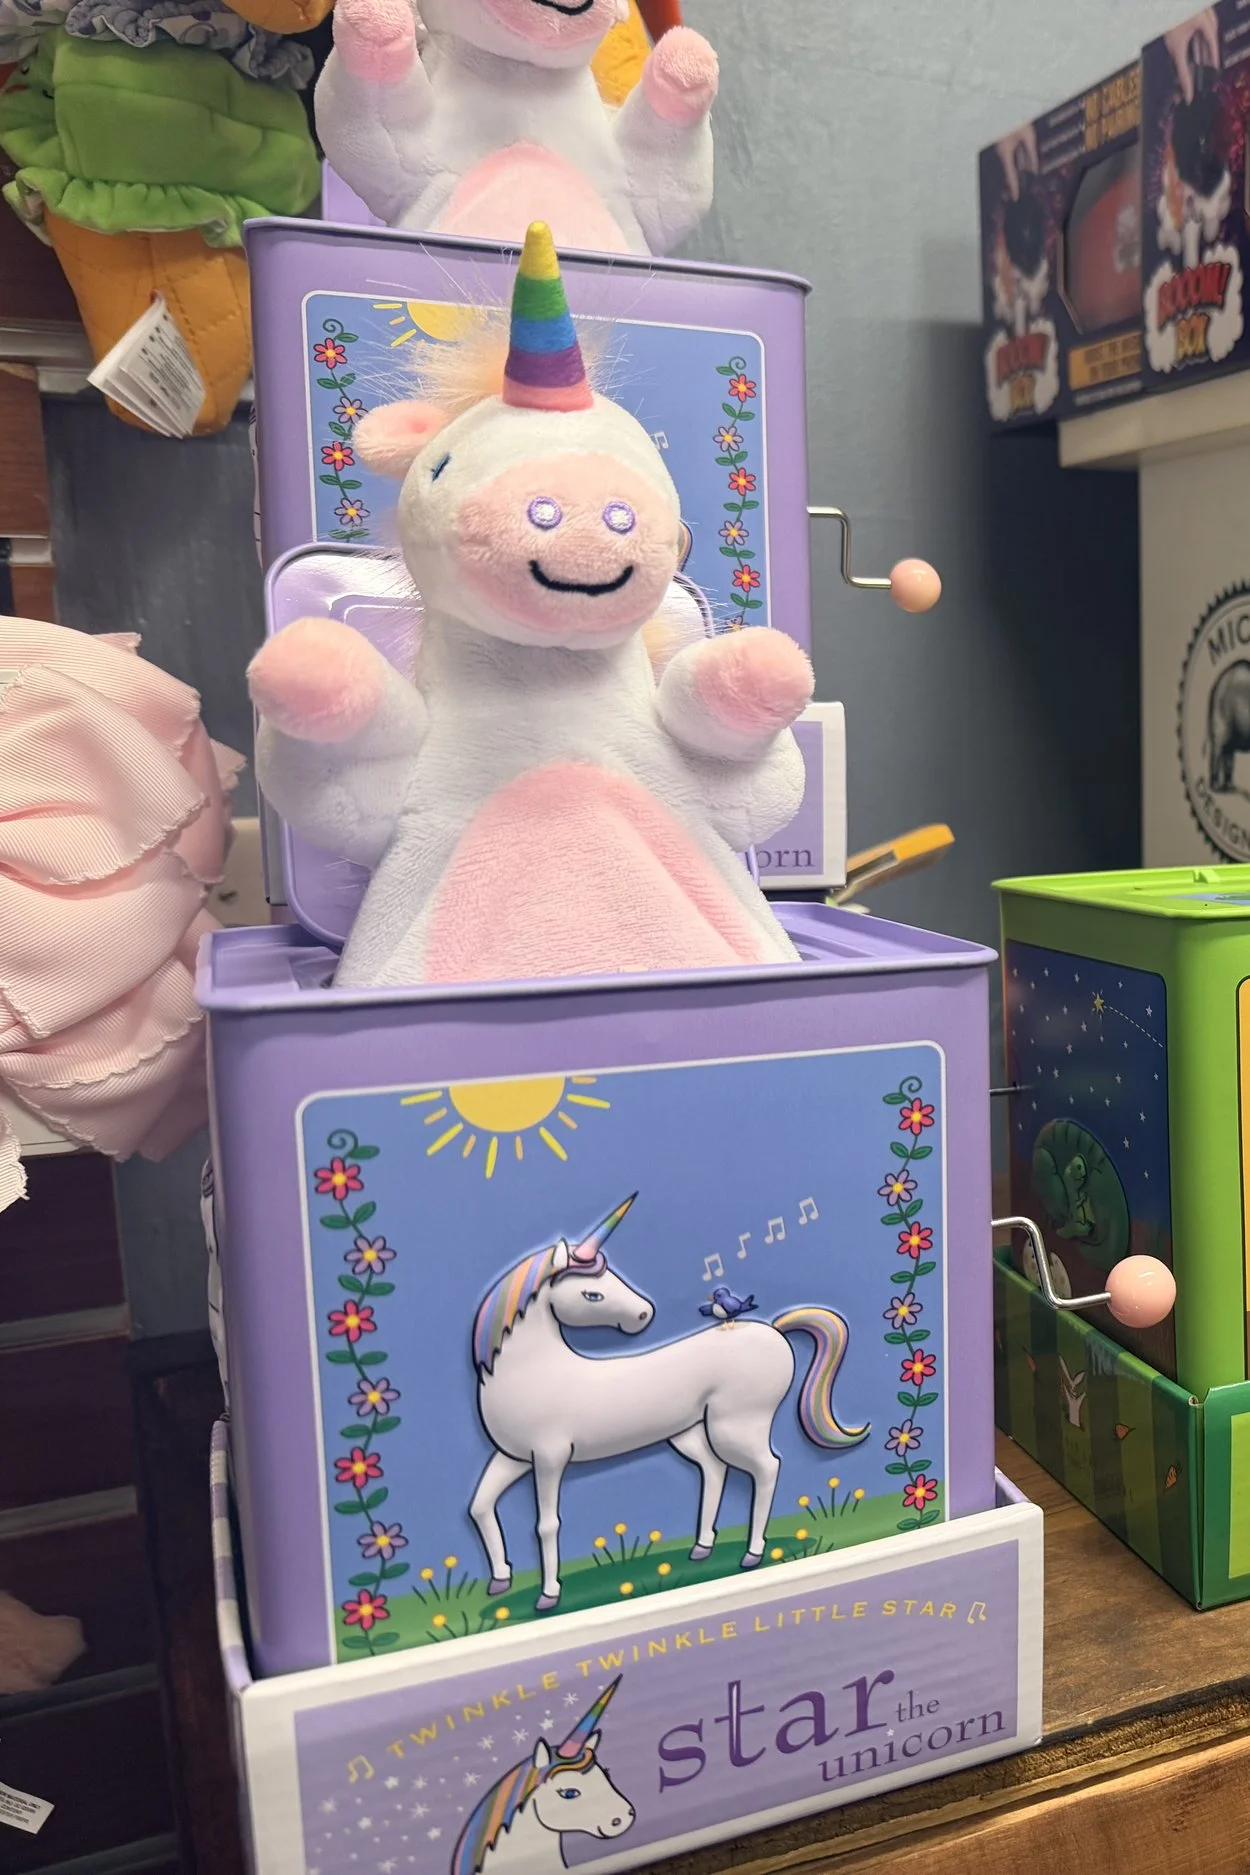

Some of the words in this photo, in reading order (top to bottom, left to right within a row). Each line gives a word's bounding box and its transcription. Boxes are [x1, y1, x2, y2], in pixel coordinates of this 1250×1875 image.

[386, 1671, 560, 1760] TWINKLE
[575, 1619, 739, 1680] TWINKLE
[754, 1602, 866, 1636] LITTLE
[880, 1598, 956, 1621] STAR
[656, 1665, 897, 1795] star
[894, 1691, 941, 1726] the
[818, 1709, 1007, 1785] unicorn
